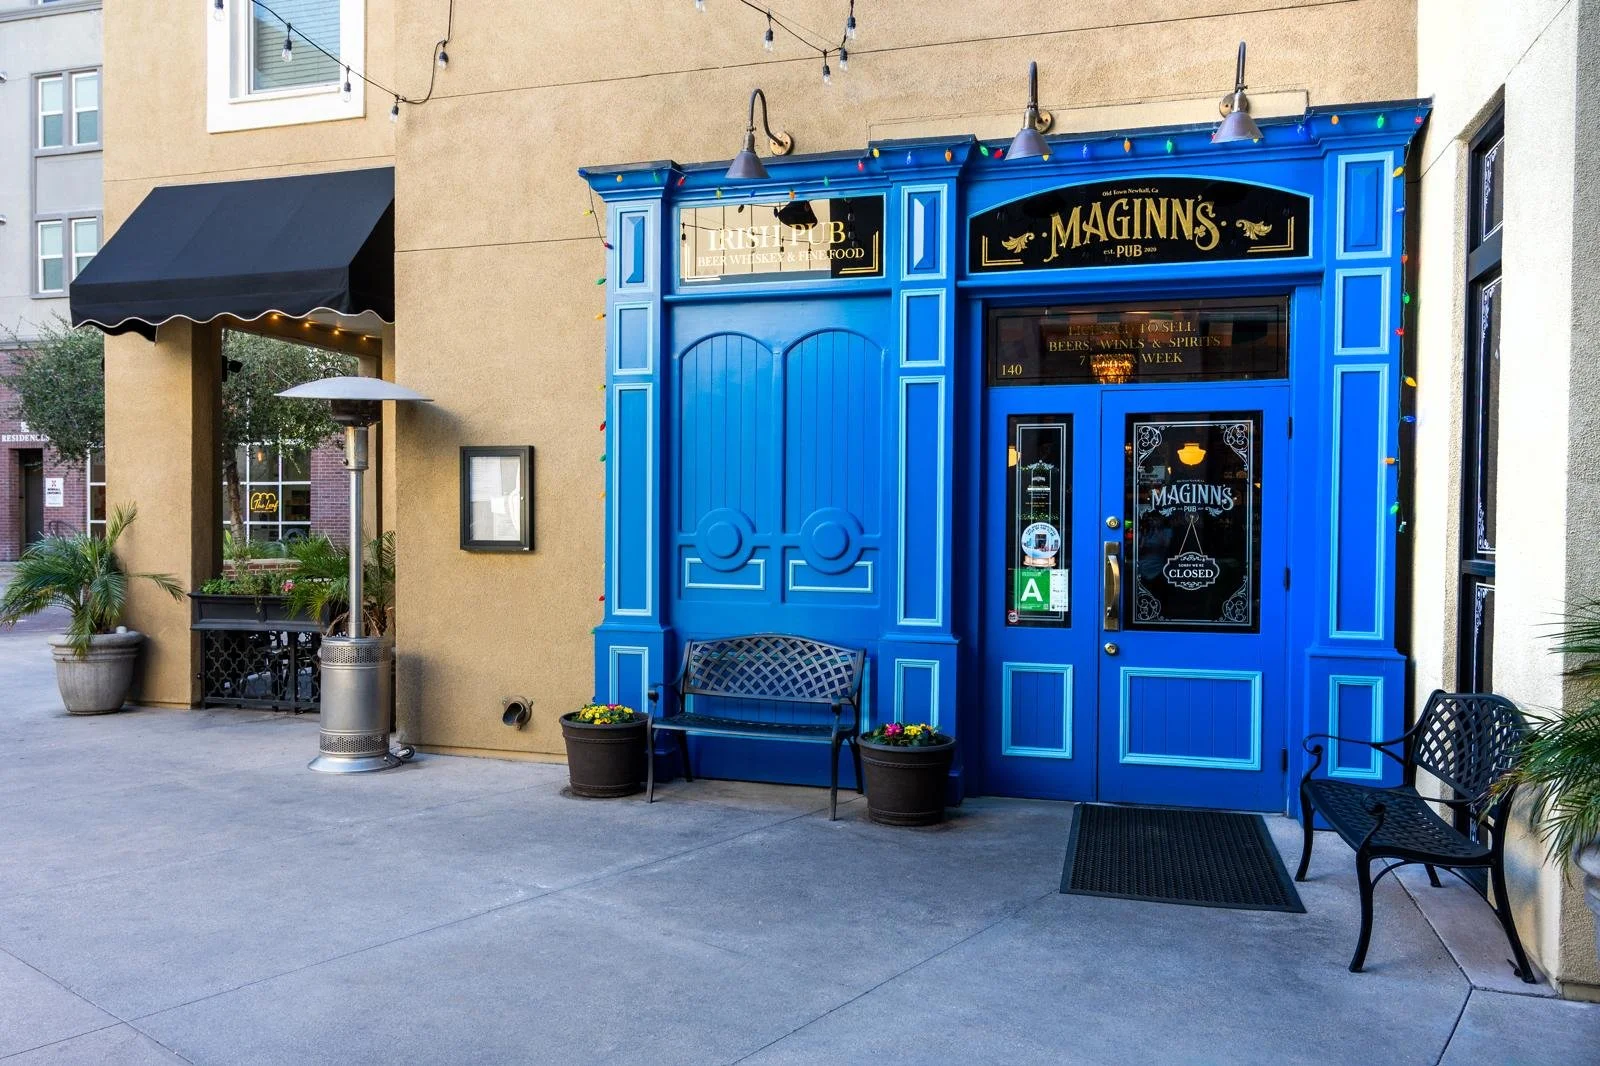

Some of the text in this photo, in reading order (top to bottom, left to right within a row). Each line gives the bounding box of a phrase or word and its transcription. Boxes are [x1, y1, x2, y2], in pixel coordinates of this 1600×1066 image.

[1043, 194, 1220, 263] MAGINN'S
[708, 221, 846, 252] IRISH PUB
[698, 247, 865, 267] BEER WHISKEY & FINE FOOD
[1116, 244, 1143, 258] PUB
[1162, 321, 1196, 333] SELL
[1049, 340, 1093, 352] BEERS,
[1152, 338, 1161, 348] &
[1169, 335, 1221, 348] SPIRITS
[1141, 352, 1183, 364] WEEK
[1001, 363, 1023, 376] 140
[1169, 569, 1214, 578] CLOSED
[1020, 578, 1043, 602] A
